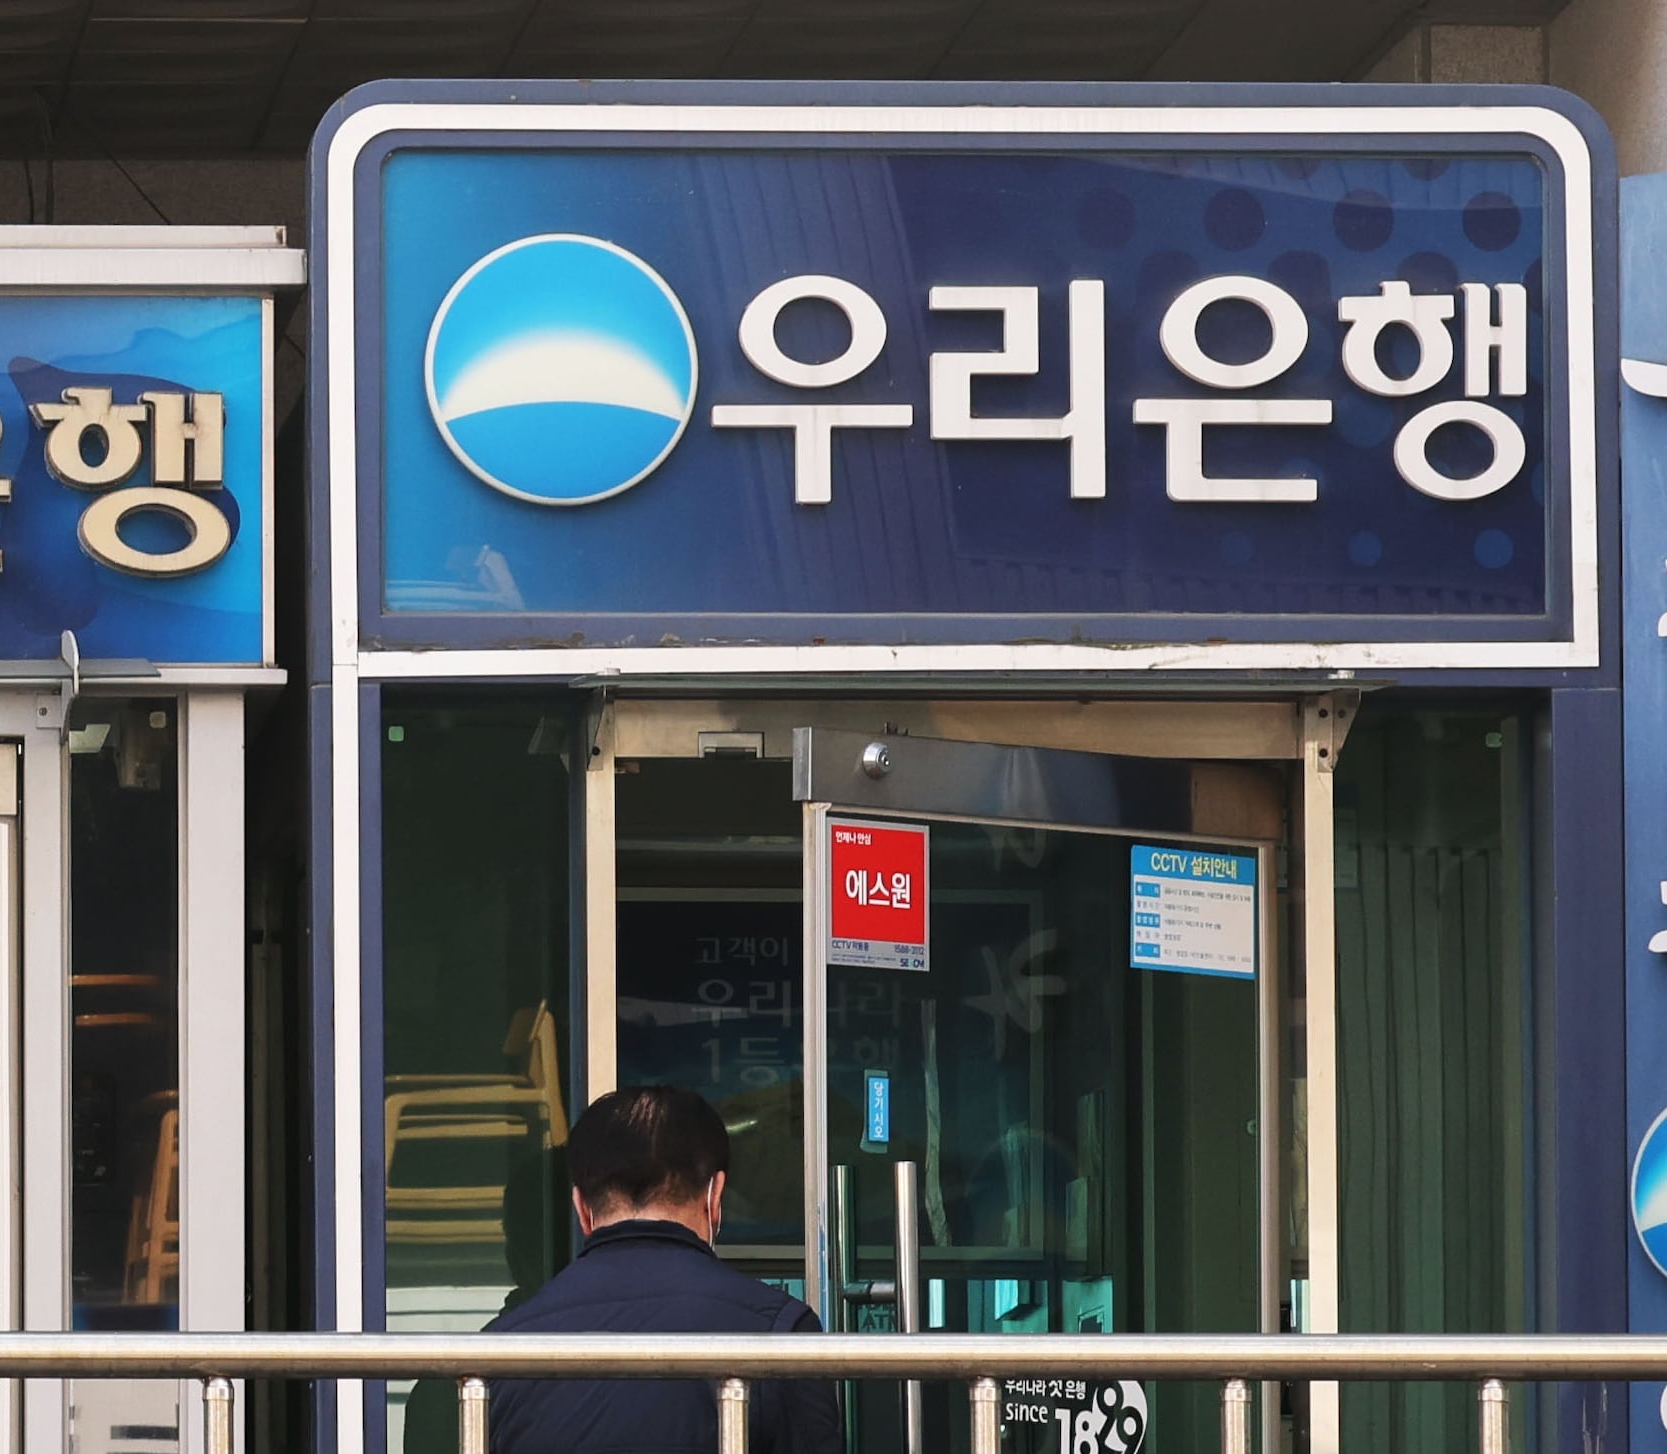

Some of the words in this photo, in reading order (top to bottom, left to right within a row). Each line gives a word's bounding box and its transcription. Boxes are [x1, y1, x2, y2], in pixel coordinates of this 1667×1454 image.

[711, 274, 1526, 506] 우리은행
[836, 831, 856, 844] 언제나
[857, 833, 871, 845] 안심
[1151, 852, 1188, 873] CCTV
[1191, 856, 1237, 880] 설치안내
[845, 869, 911, 910] 에스원
[832, 940, 851, 949] CCTV
[874, 1081, 884, 1138] 당기시오
